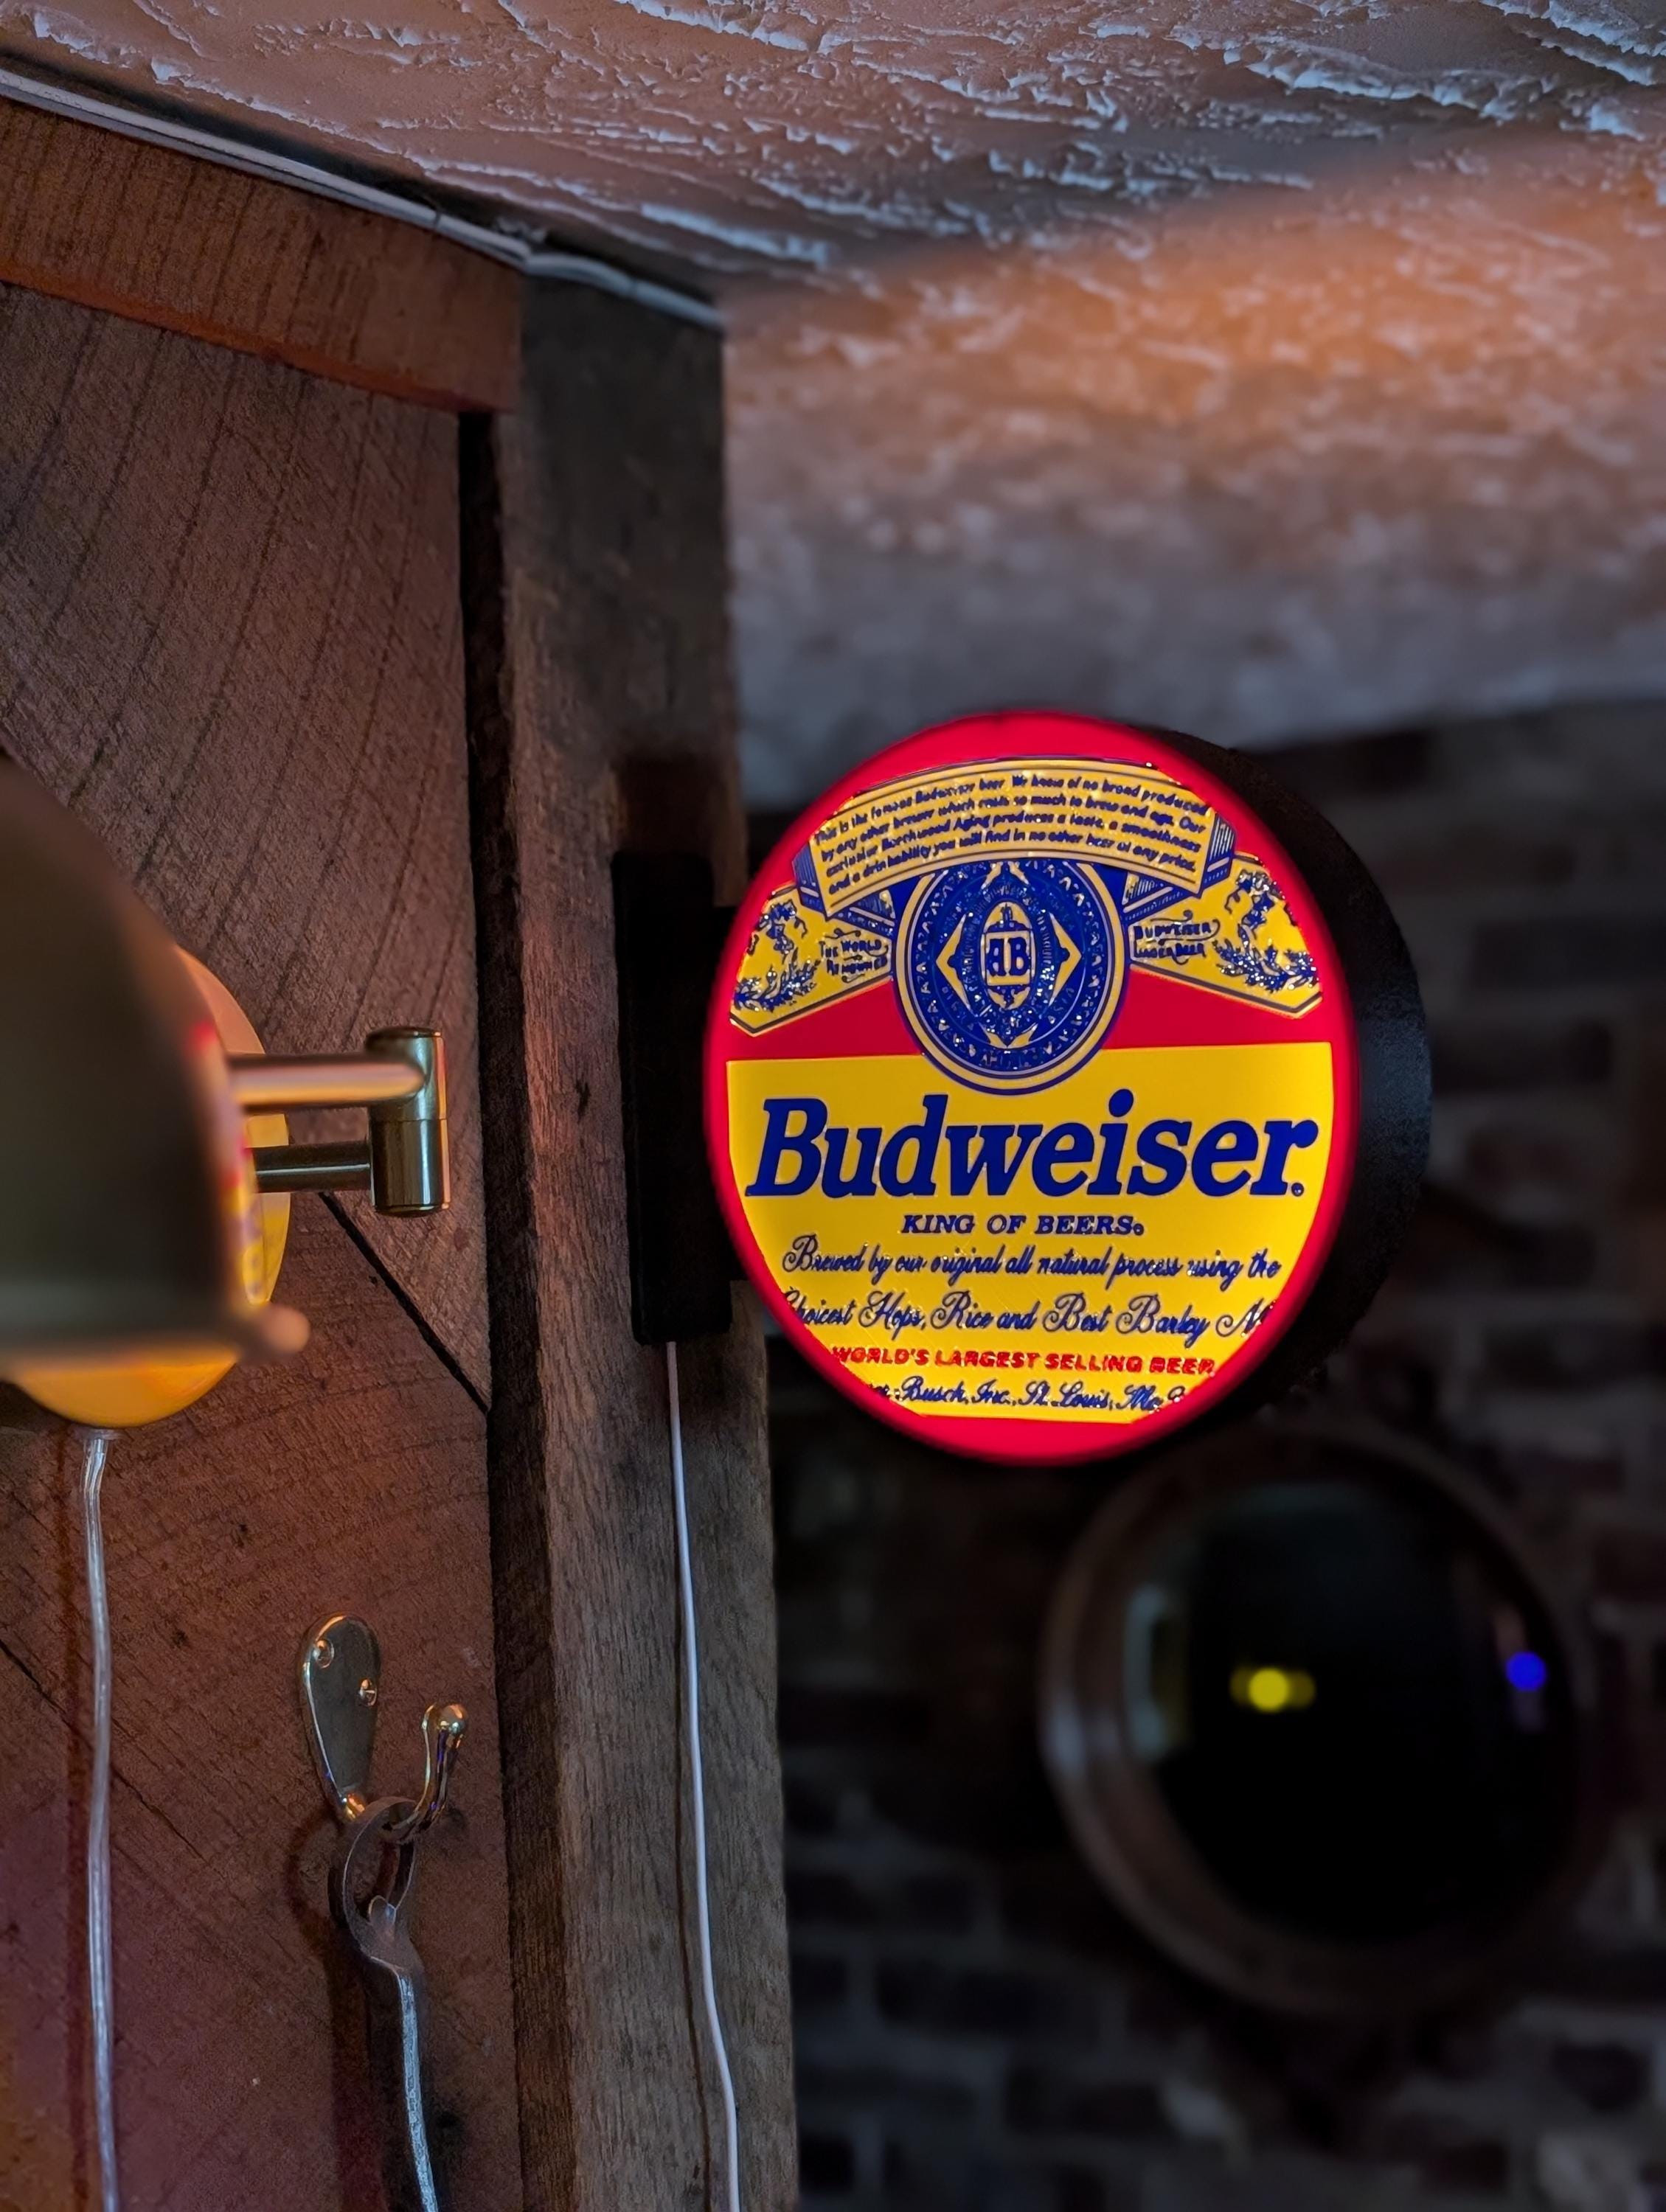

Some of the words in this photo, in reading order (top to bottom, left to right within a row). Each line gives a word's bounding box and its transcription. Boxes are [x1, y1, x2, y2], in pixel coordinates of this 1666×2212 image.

[900, 1214, 975, 1234] KING
[986, 1214, 1027, 1234] OF
[782, 1233, 865, 1273] Brewed
[868, 1244, 893, 1285] by
[894, 1255, 927, 1273] our
[930, 1244, 1007, 1287] original
[1004, 1244, 1036, 1274] all
[1036, 1245, 1114, 1276] natural
[1105, 1252, 1184, 1291] process
[1186, 1249, 1244, 1292] using
[1247, 1248, 1283, 1279] the
[930, 1290, 994, 1330] Rice
[996, 1300, 1042, 1330] and
[1041, 1292, 1112, 1333] Best
[1115, 1293, 1212, 1349] Barley
[832, 1346, 930, 1366] WORLD'S
[935, 1349, 1040, 1368] LARGEST
[1044, 1352, 1142, 1374] SELLING
[1148, 1357, 1216, 1375] BEER
